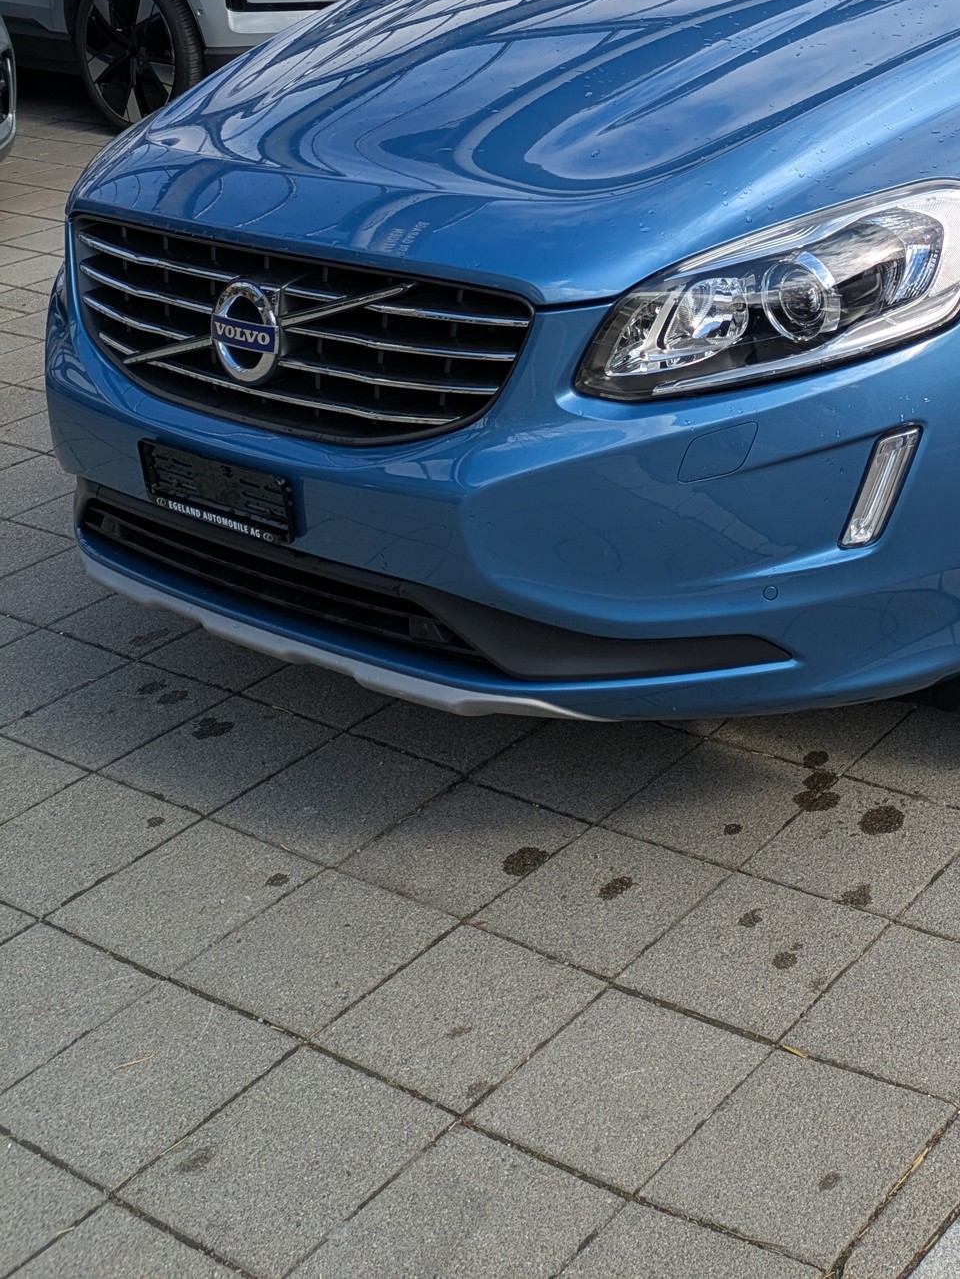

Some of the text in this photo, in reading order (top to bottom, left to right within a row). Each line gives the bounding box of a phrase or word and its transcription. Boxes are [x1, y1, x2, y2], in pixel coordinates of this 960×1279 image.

[215, 321, 270, 345] VOLVO
[168, 500, 261, 538] EGELAND AUTOMOBILE AG
